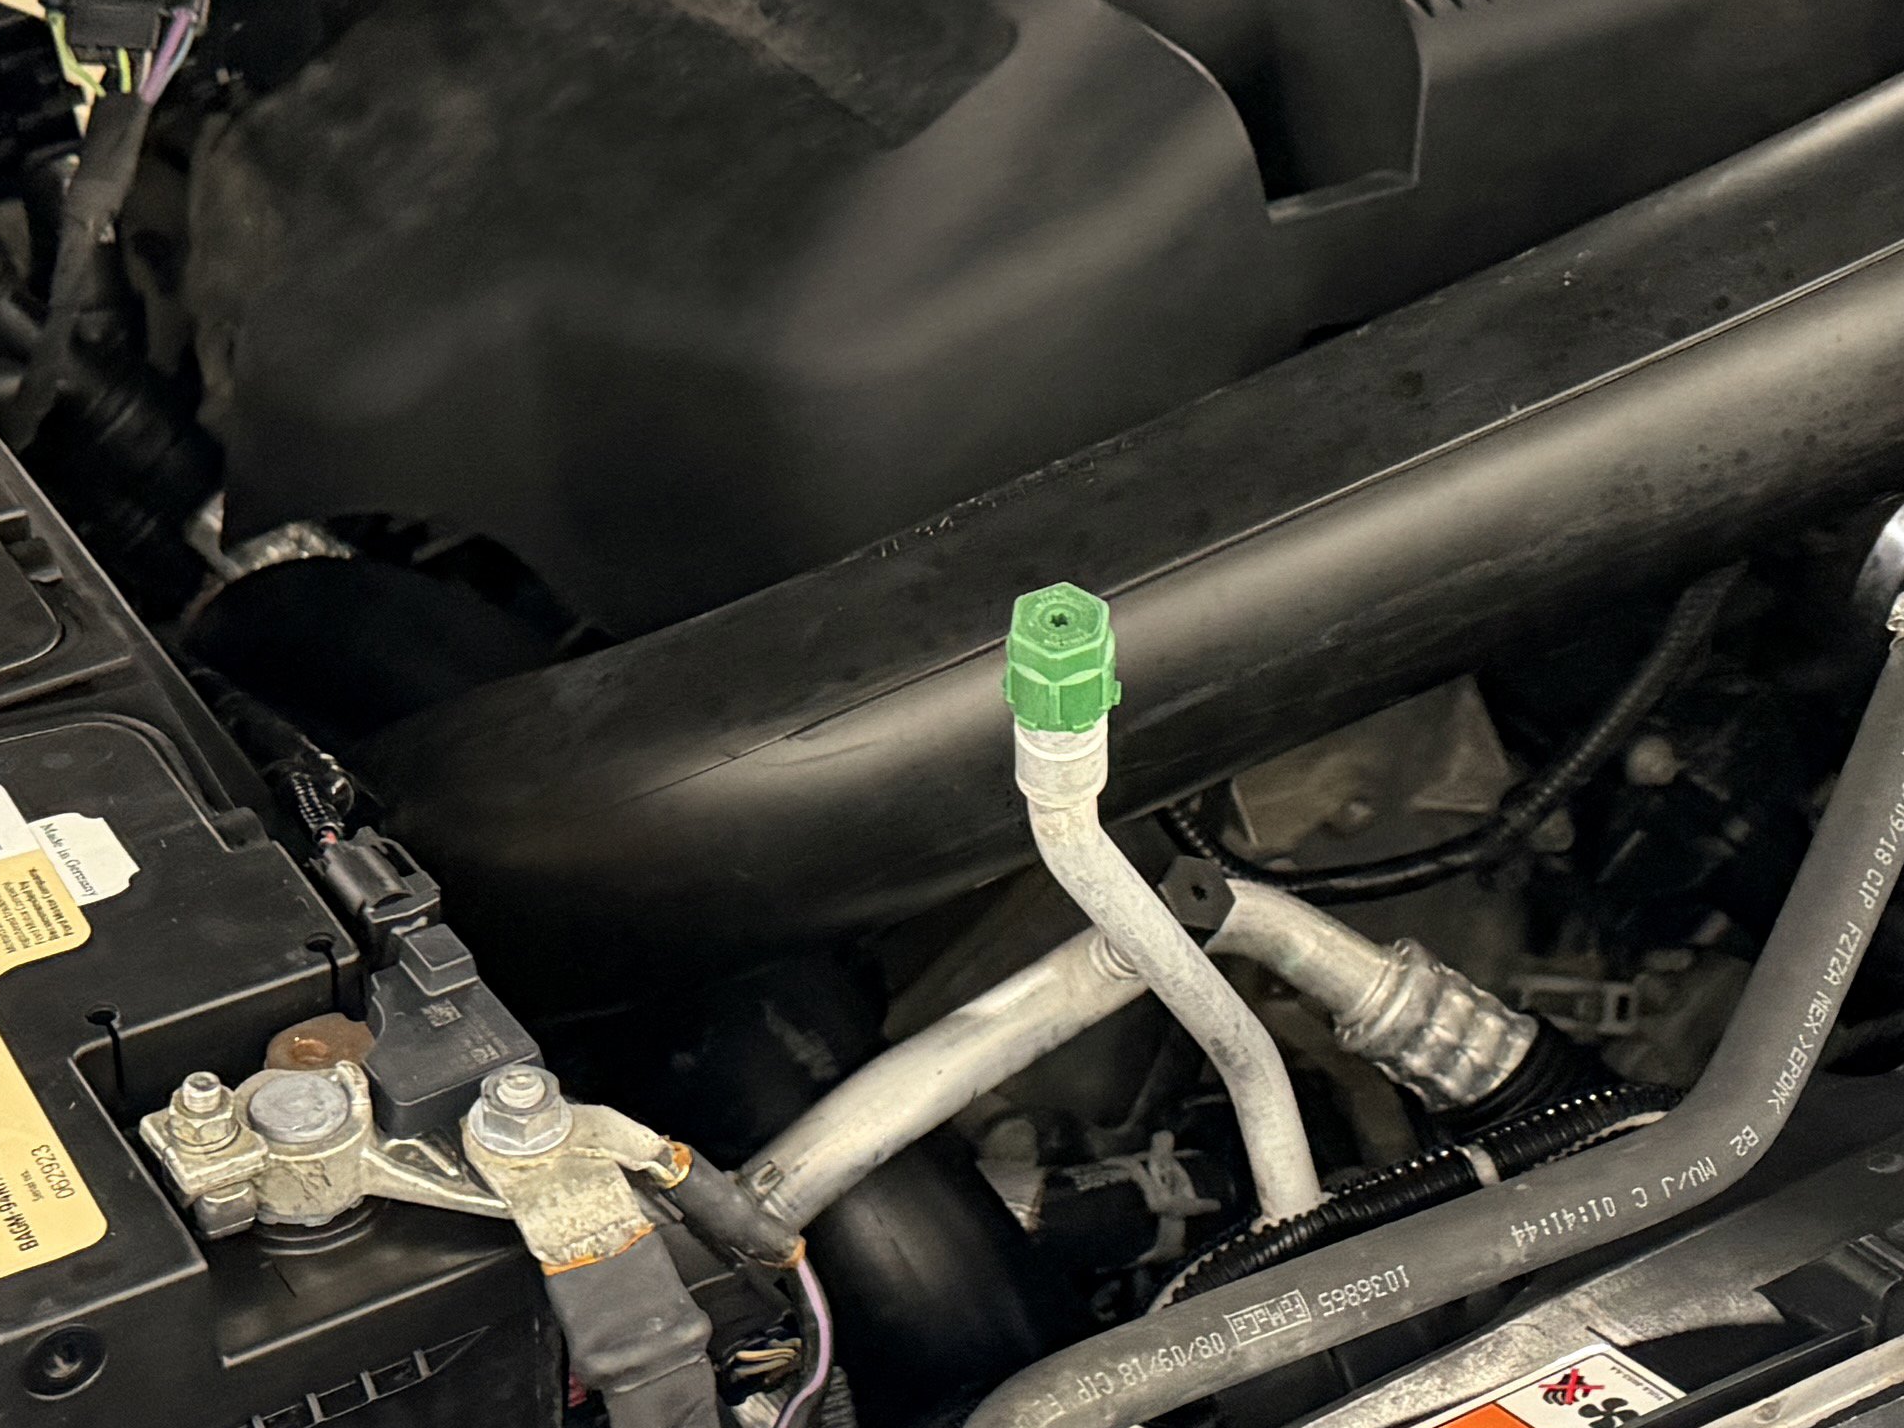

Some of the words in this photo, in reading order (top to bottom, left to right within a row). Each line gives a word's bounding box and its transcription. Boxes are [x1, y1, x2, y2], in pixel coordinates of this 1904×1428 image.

[66, 858, 97, 896] Germany
[1858, 868, 1884, 910] CIP
[1803, 990, 1833, 1035] MEX
[1729, 1124, 1760, 1157] B2
[24, 1181, 44, 1202] Serial
[30, 1144, 75, 1199] 062923
[1631, 1187, 1648, 1209] C
[1510, 1196, 1617, 1249] 01:41:44
[1317, 1264, 1412, 1318] 1036865
[1230, 1294, 1309, 1340] FoMoCo
[1117, 1331, 1227, 1388] 08/09/18
[1077, 1371, 1115, 1404] CIP
